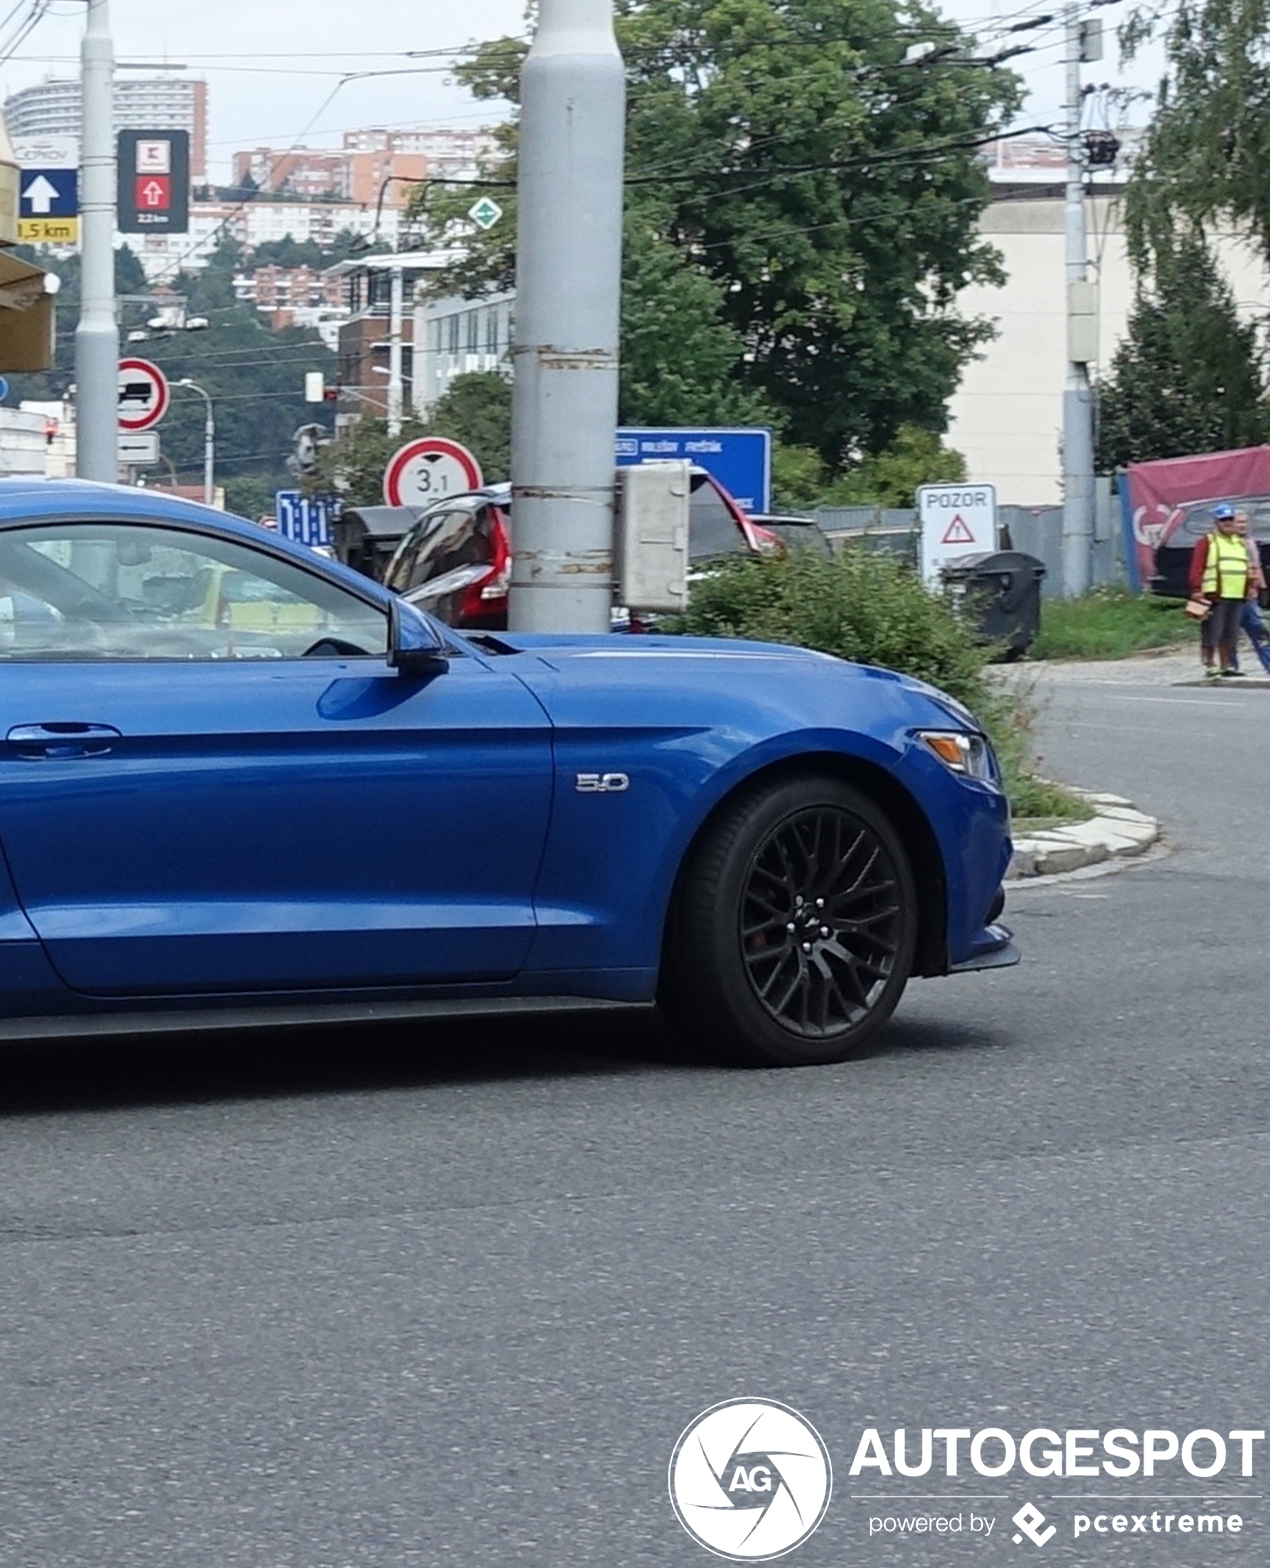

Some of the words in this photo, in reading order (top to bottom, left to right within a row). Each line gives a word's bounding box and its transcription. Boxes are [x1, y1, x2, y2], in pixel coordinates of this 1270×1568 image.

[17, 223, 40, 239] 1,5
[44, 223, 70, 238] km
[926, 491, 988, 509] POZOR
